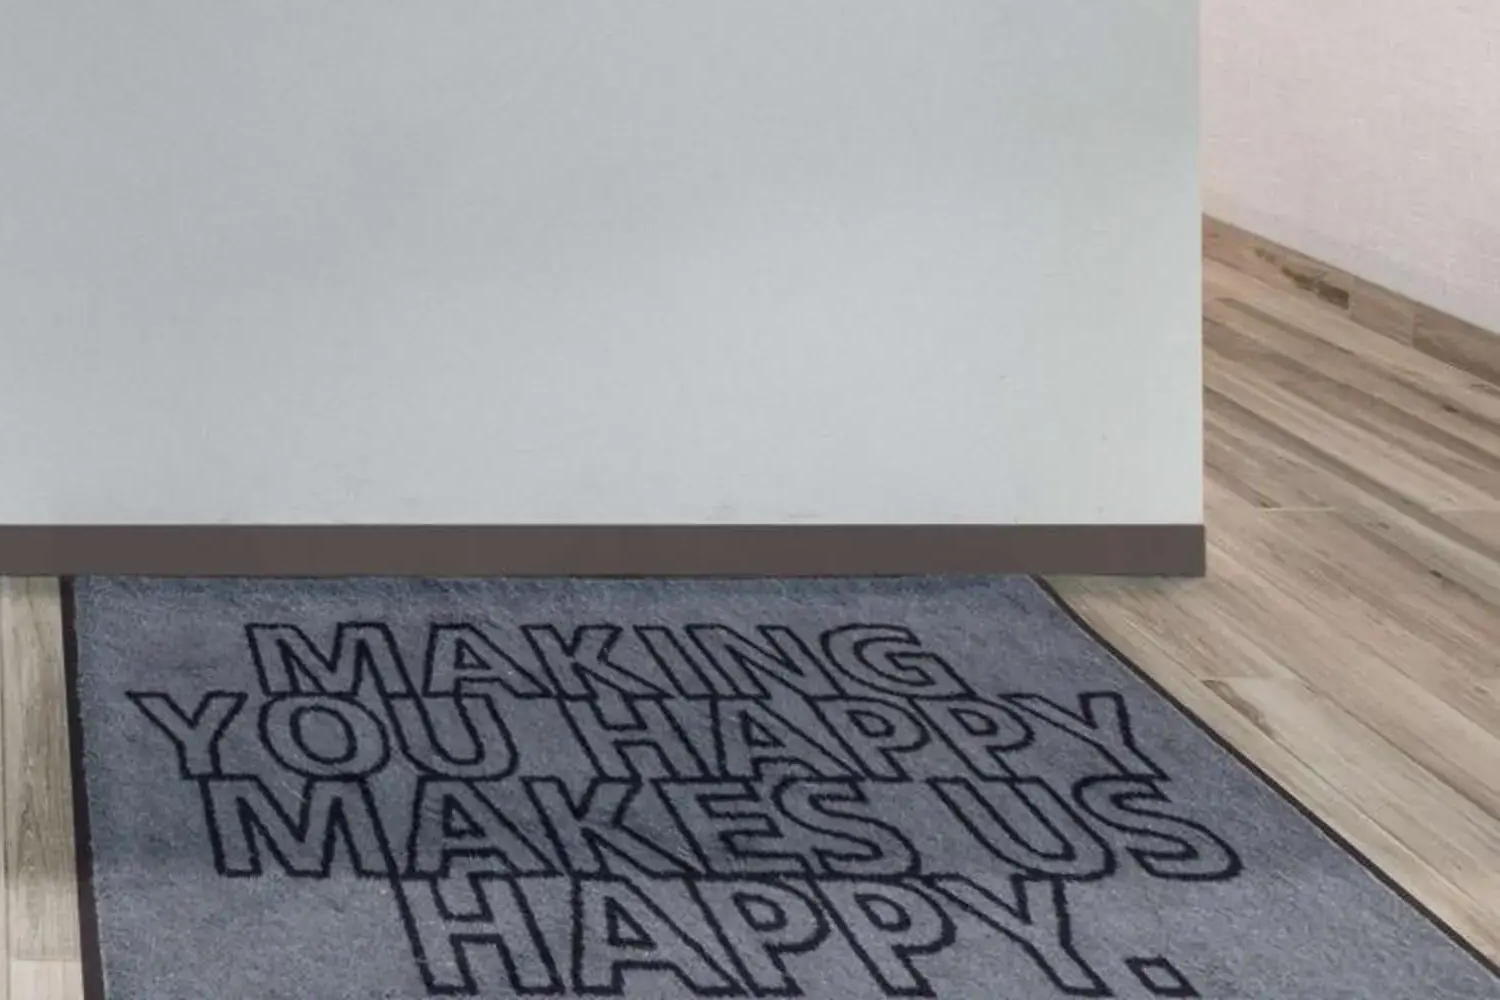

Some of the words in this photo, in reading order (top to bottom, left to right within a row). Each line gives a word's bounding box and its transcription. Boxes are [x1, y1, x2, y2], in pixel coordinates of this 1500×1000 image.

[245, 621, 976, 699] MAKING
[124, 690, 518, 782] YOU
[554, 690, 1171, 783] HAPPY
[199, 774, 922, 880] MAKES
[926, 772, 1245, 881] US
[389, 872, 1201, 998] HAPPY.
